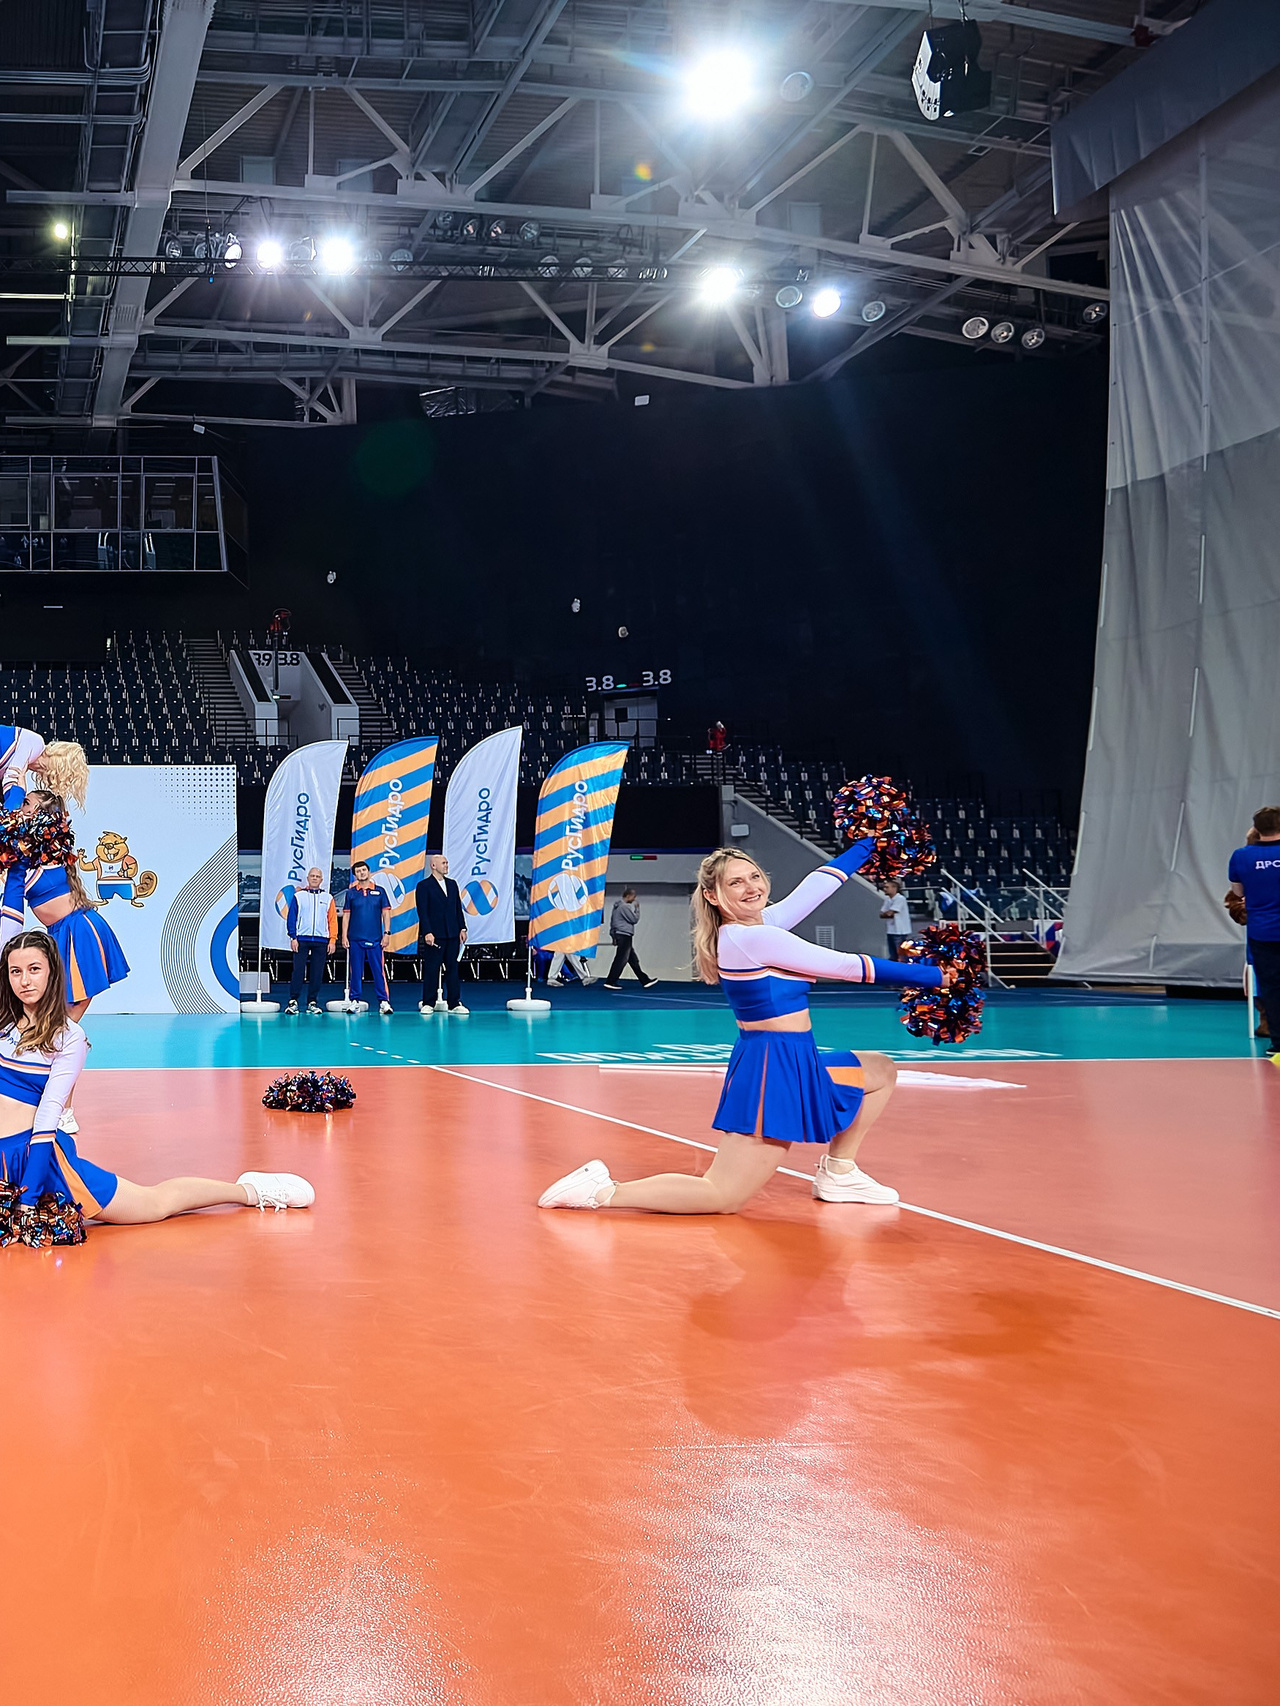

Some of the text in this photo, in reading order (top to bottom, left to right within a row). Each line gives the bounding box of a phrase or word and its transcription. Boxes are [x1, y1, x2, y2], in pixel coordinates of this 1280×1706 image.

[278, 652, 300, 666] 3.8
[585, 669, 672, 692] 3.8 3.8
[287, 792, 310, 883] РусГидро
[380, 778, 403, 870] РусГидро
[472, 787, 491, 876] РусГидро
[562, 780, 589, 872] РусГидро
